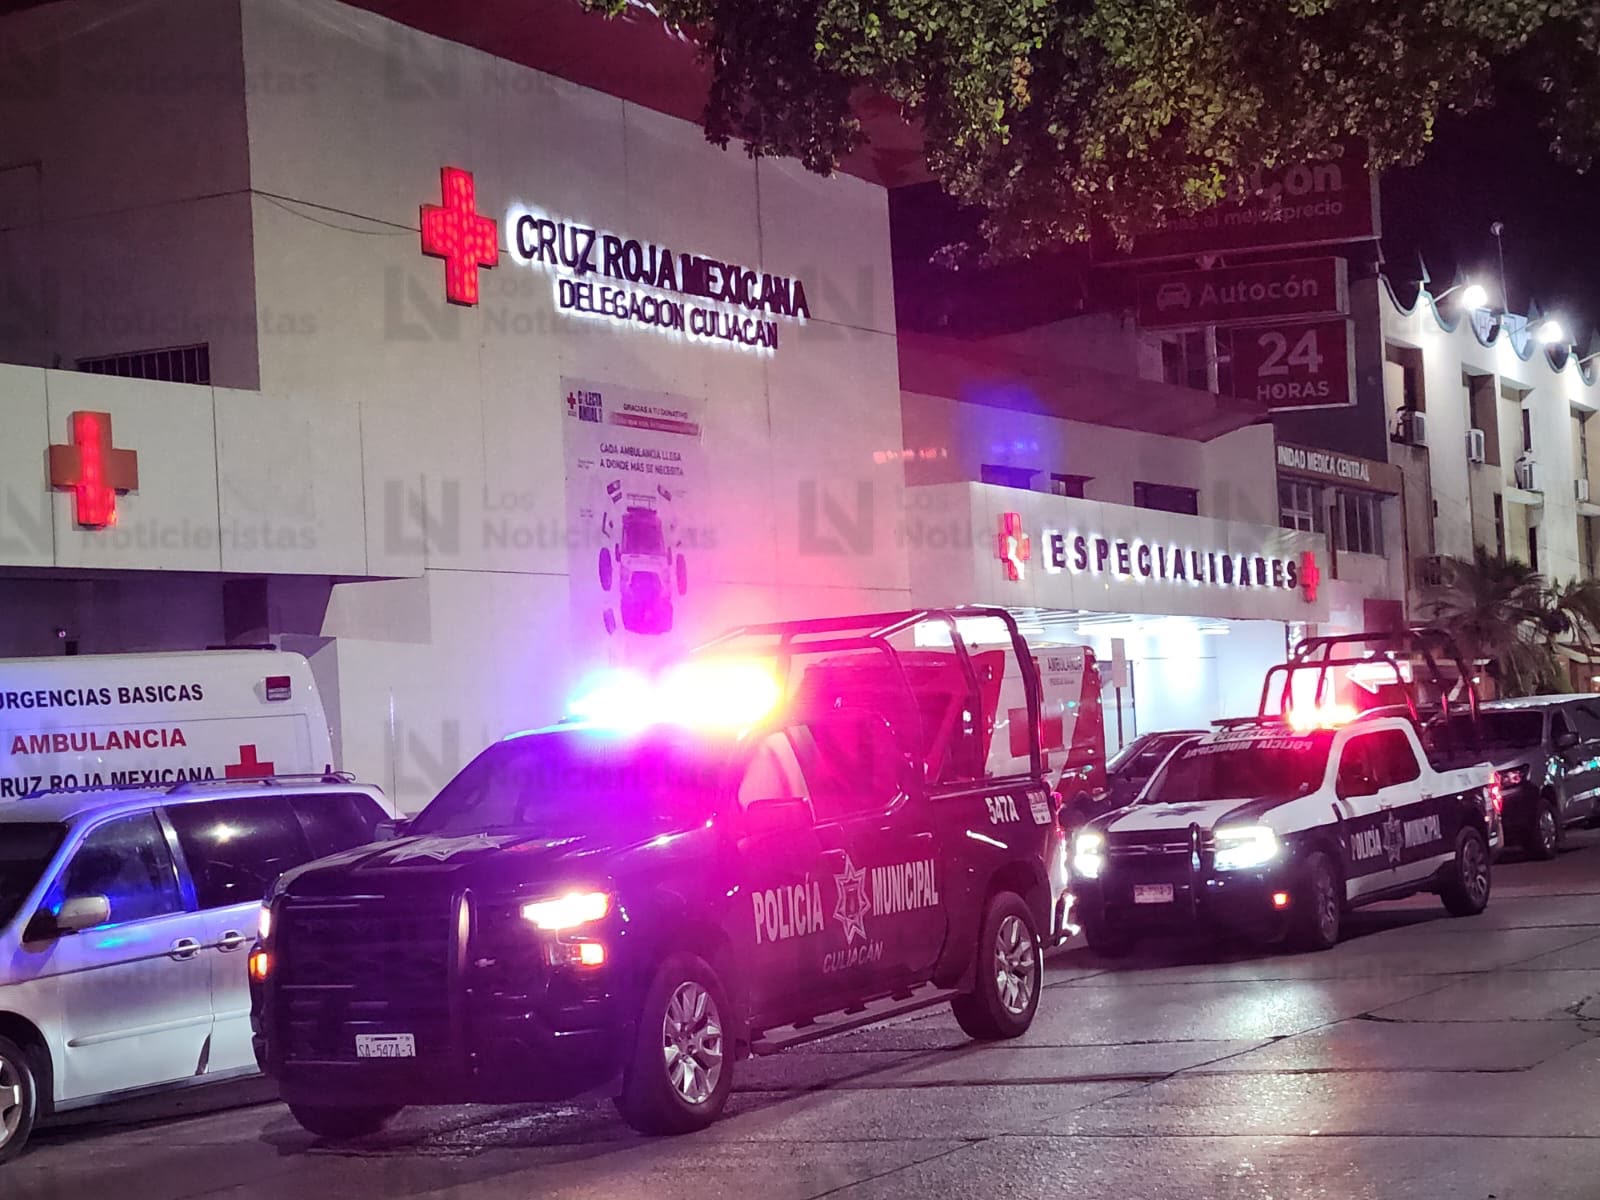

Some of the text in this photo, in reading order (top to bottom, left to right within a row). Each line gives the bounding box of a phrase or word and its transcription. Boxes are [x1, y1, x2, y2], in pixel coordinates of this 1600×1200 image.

[1282, 201, 1343, 224] precio
[516, 213, 811, 319] CRUZ ROJA MEXICANA
[1199, 274, 1319, 306] Autocón
[558, 279, 686, 332] DELEGACION
[689, 307, 778, 350] CULIACAN
[1257, 328, 1324, 378] 24
[1256, 380, 1330, 400] HORAS
[623, 403, 648, 414] GRACIAS
[600, 443, 682, 462] CADA AMBULANCIA LLEGA
[600, 458, 605, 468] A
[606, 459, 630, 471] DONDE
[645, 463, 654, 474] SE
[655, 464, 684, 476] NECESITA
[1277, 446, 1306, 469] NIDAD
[1050, 533, 1298, 590] ESPECIALIDADES
[0, 683, 204, 711] RGENCIAS BASICAS
[10, 727, 187, 756] AMBULANCIA
[0, 766, 215, 798] RUZ ROJA MEXICANA
[984, 794, 1020, 825] 547A
[751, 858, 939, 945] POLICÍA MUNICIPAL
[822, 938, 884, 974] CULIACÁN
